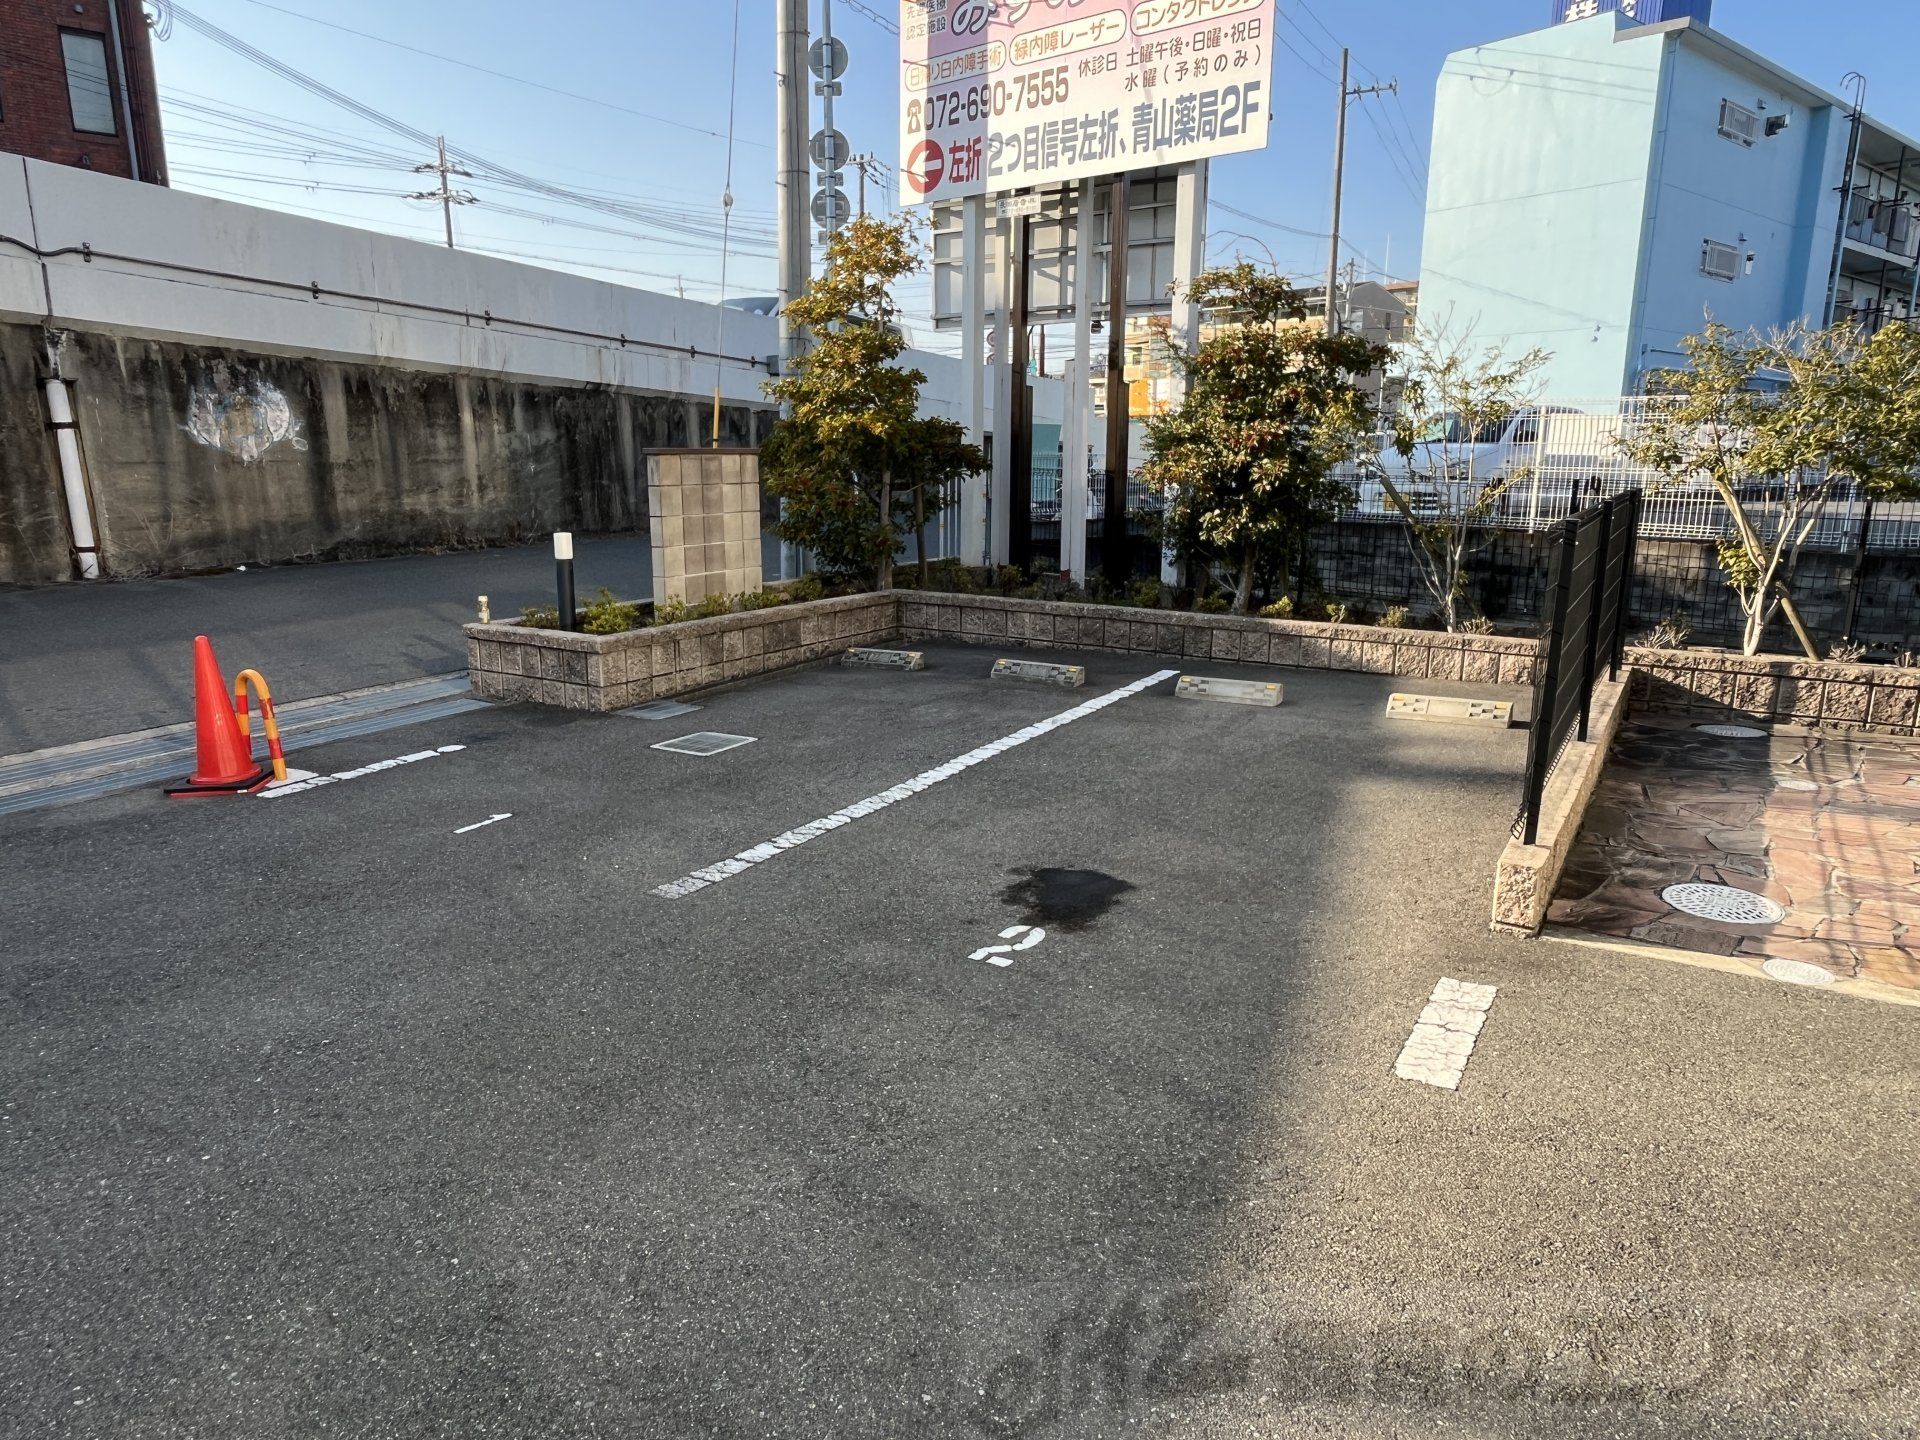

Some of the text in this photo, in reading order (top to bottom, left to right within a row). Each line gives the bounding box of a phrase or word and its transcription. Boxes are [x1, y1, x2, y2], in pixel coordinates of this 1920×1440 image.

[1014, 18, 1120, 61] 緑内障レーザー
[1078, 18, 1261, 78] 休診日 土曜午後・日曜・祝日
[924, 65, 1069, 131] 072-690-7555
[948, 80, 1261, 184] 左折 2つ目信号左折、青山薬局2F
[453, 813, 513, 833] 1
[967, 924, 1046, 967] 2
